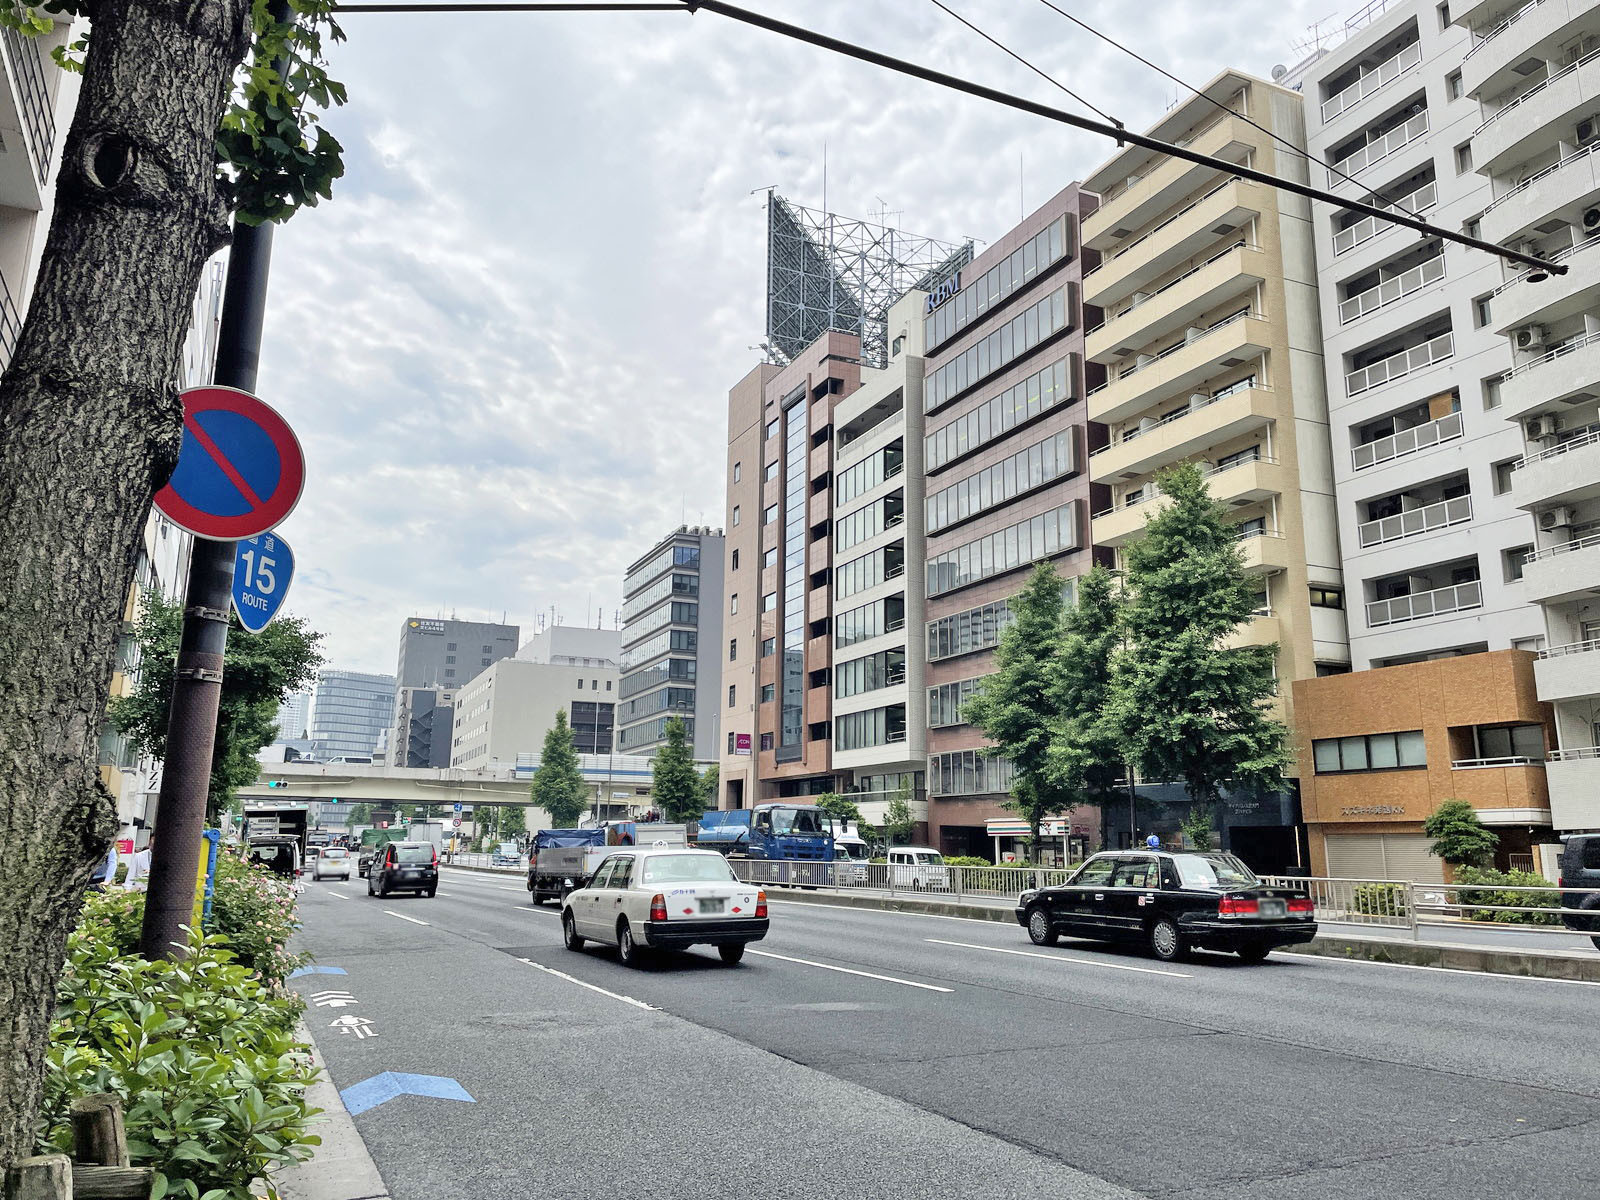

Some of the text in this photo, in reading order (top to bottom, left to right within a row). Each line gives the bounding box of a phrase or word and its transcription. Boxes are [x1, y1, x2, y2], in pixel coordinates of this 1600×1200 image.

[927, 271, 962, 313] RBM
[242, 549, 276, 595] 15
[242, 591, 269, 612] ROUTE
